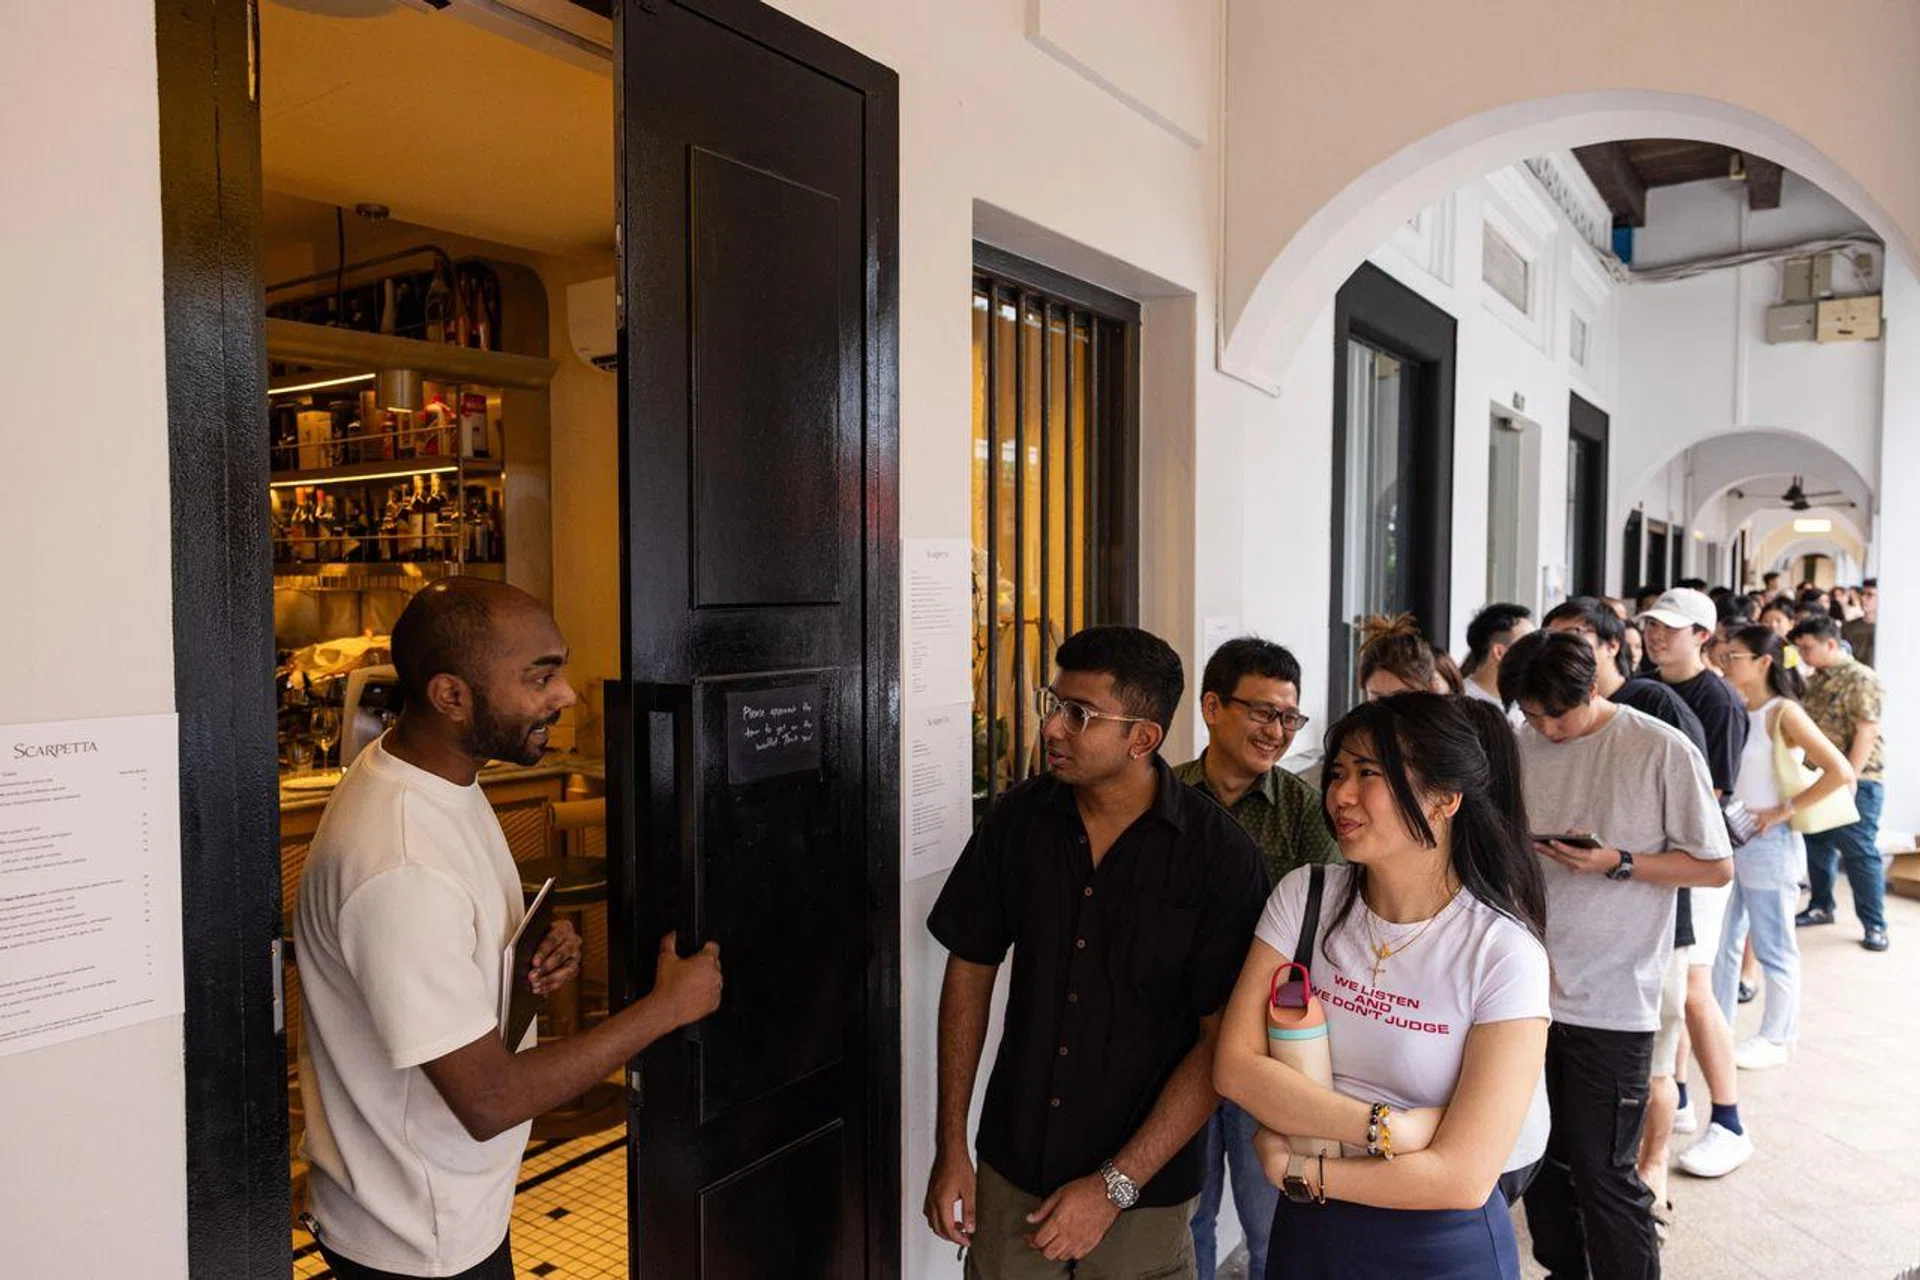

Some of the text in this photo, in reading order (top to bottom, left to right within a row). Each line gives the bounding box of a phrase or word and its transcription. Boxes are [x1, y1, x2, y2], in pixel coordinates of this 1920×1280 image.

[13, 742, 98, 759] SCARPETTA
[1334, 974, 1420, 1009] WE LISTEN
[1354, 994, 1392, 1013] AND
[1309, 983, 1450, 1035] WE DON'T JUDGE
